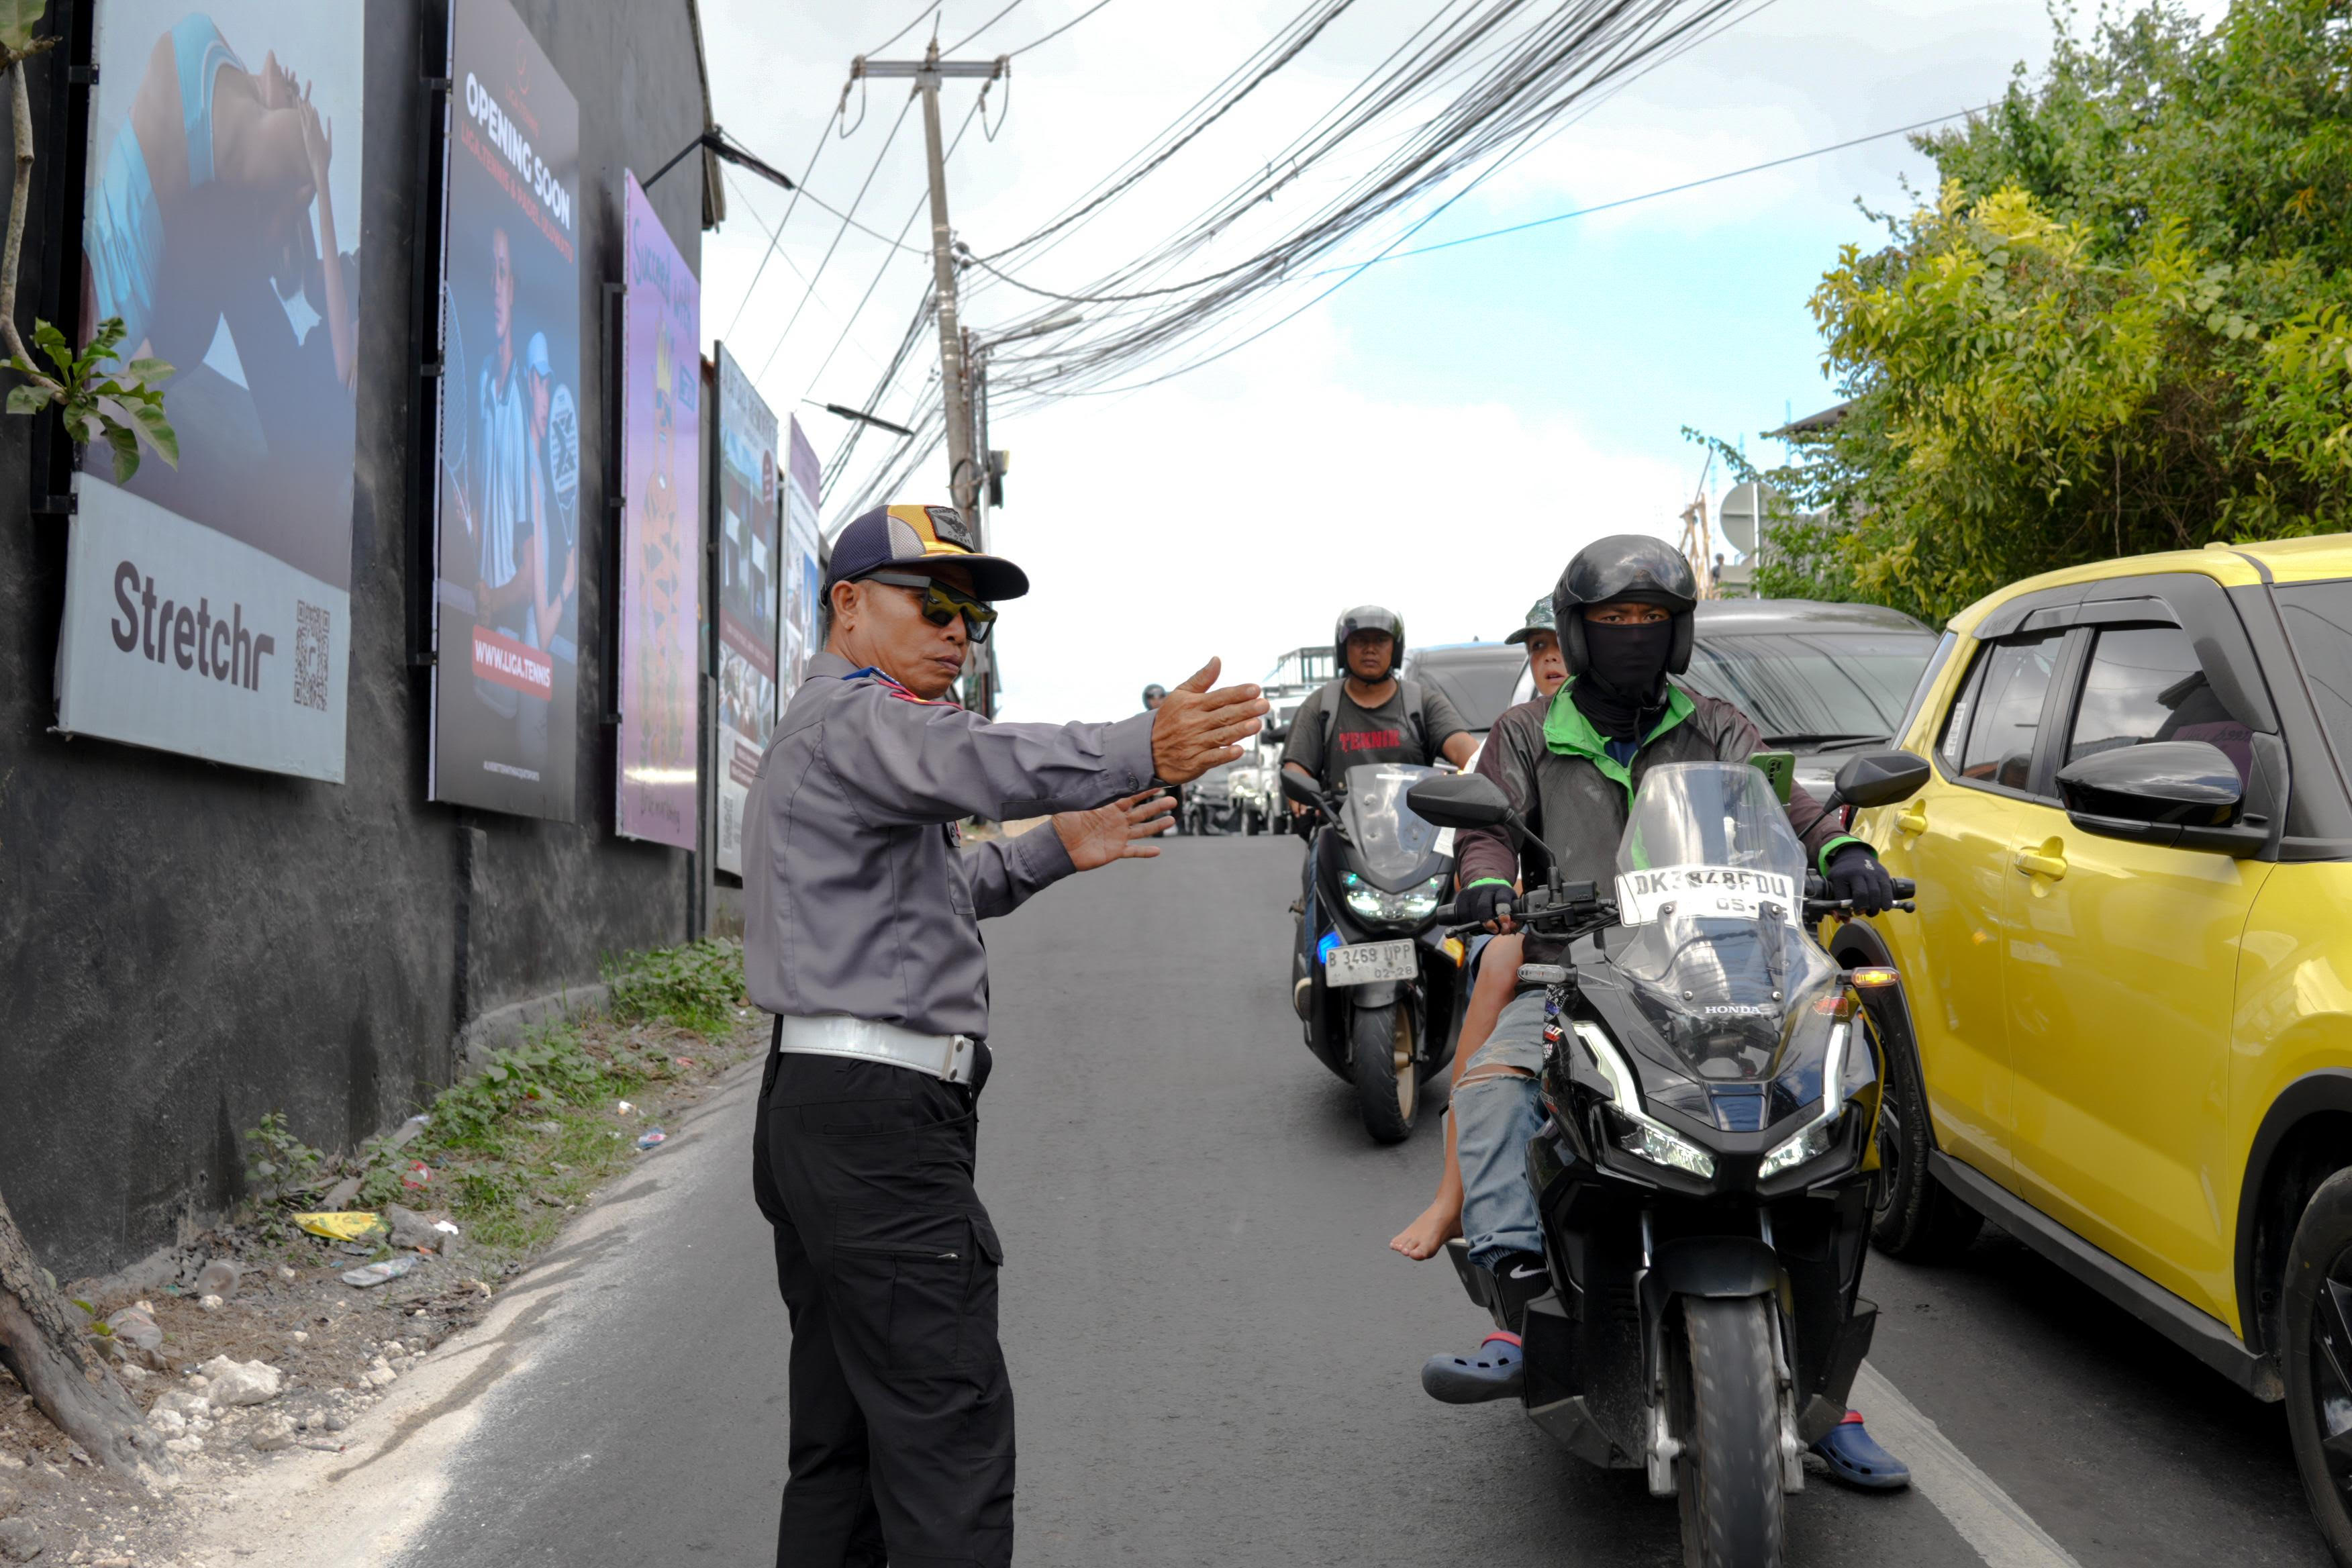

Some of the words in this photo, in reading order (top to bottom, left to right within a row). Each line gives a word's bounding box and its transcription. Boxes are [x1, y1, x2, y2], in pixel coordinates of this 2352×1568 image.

[465, 71, 532, 184] OPENING
[534, 155, 571, 231] SOON
[111, 560, 275, 693] Stretchr
[475, 639, 551, 689] WWW.LIGA.TENNIS
[1328, 952, 1336, 967] B
[1342, 947, 1378, 965] 3469
[1384, 944, 1410, 962] UPP
[1374, 966, 1413, 979] 02-28
[1704, 1006, 1762, 1014] HONDA
